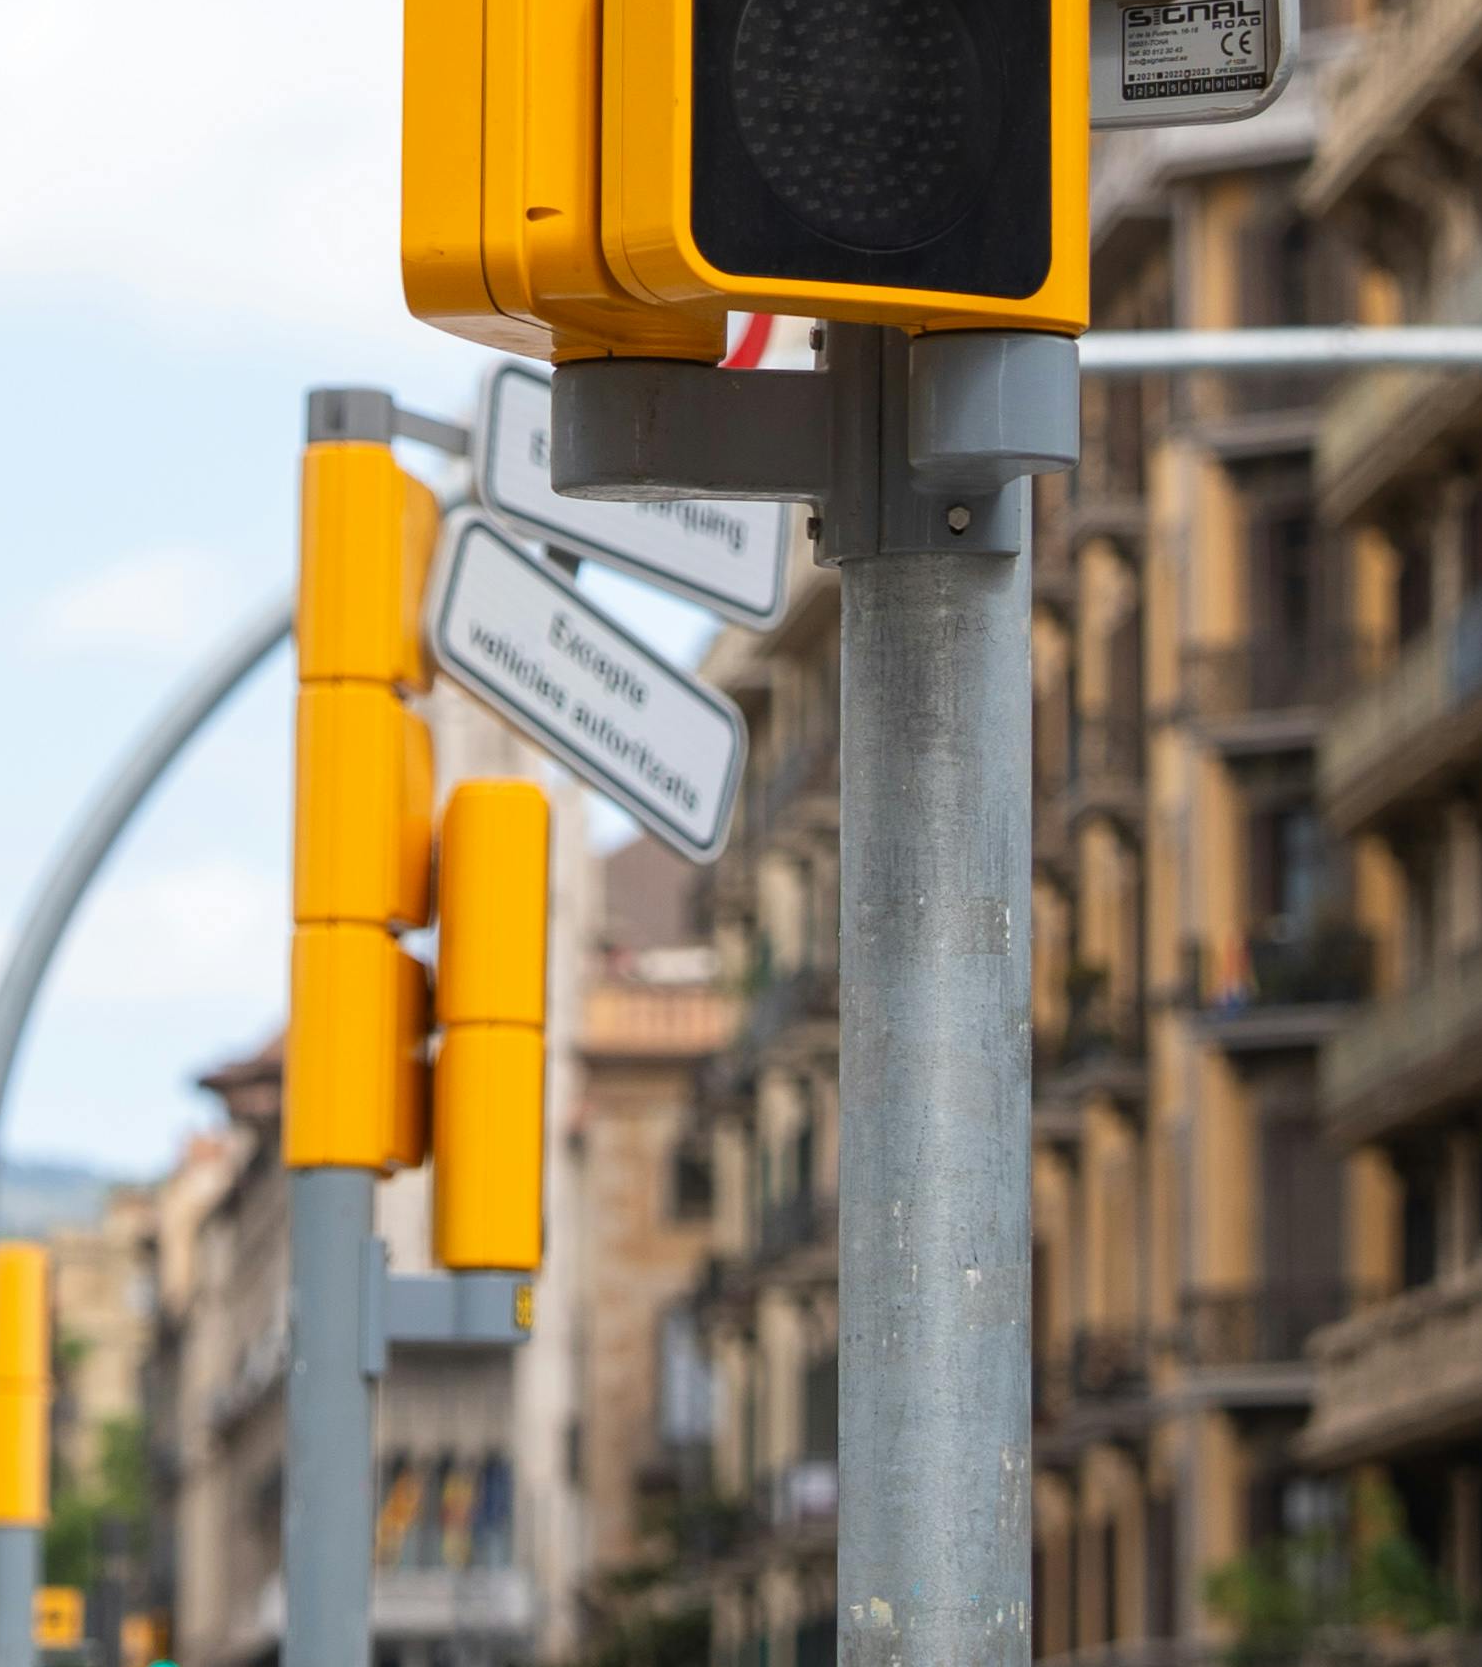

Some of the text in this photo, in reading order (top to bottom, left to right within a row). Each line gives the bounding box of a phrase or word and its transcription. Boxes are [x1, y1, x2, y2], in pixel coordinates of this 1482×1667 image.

[1212, 17, 1261, 31] ROAD
[1136, 72, 1155, 81] 2021
[1164, 70, 1183, 79] 2022
[1192, 68, 1210, 76] 2023
[470, 624, 567, 709] vehicles
